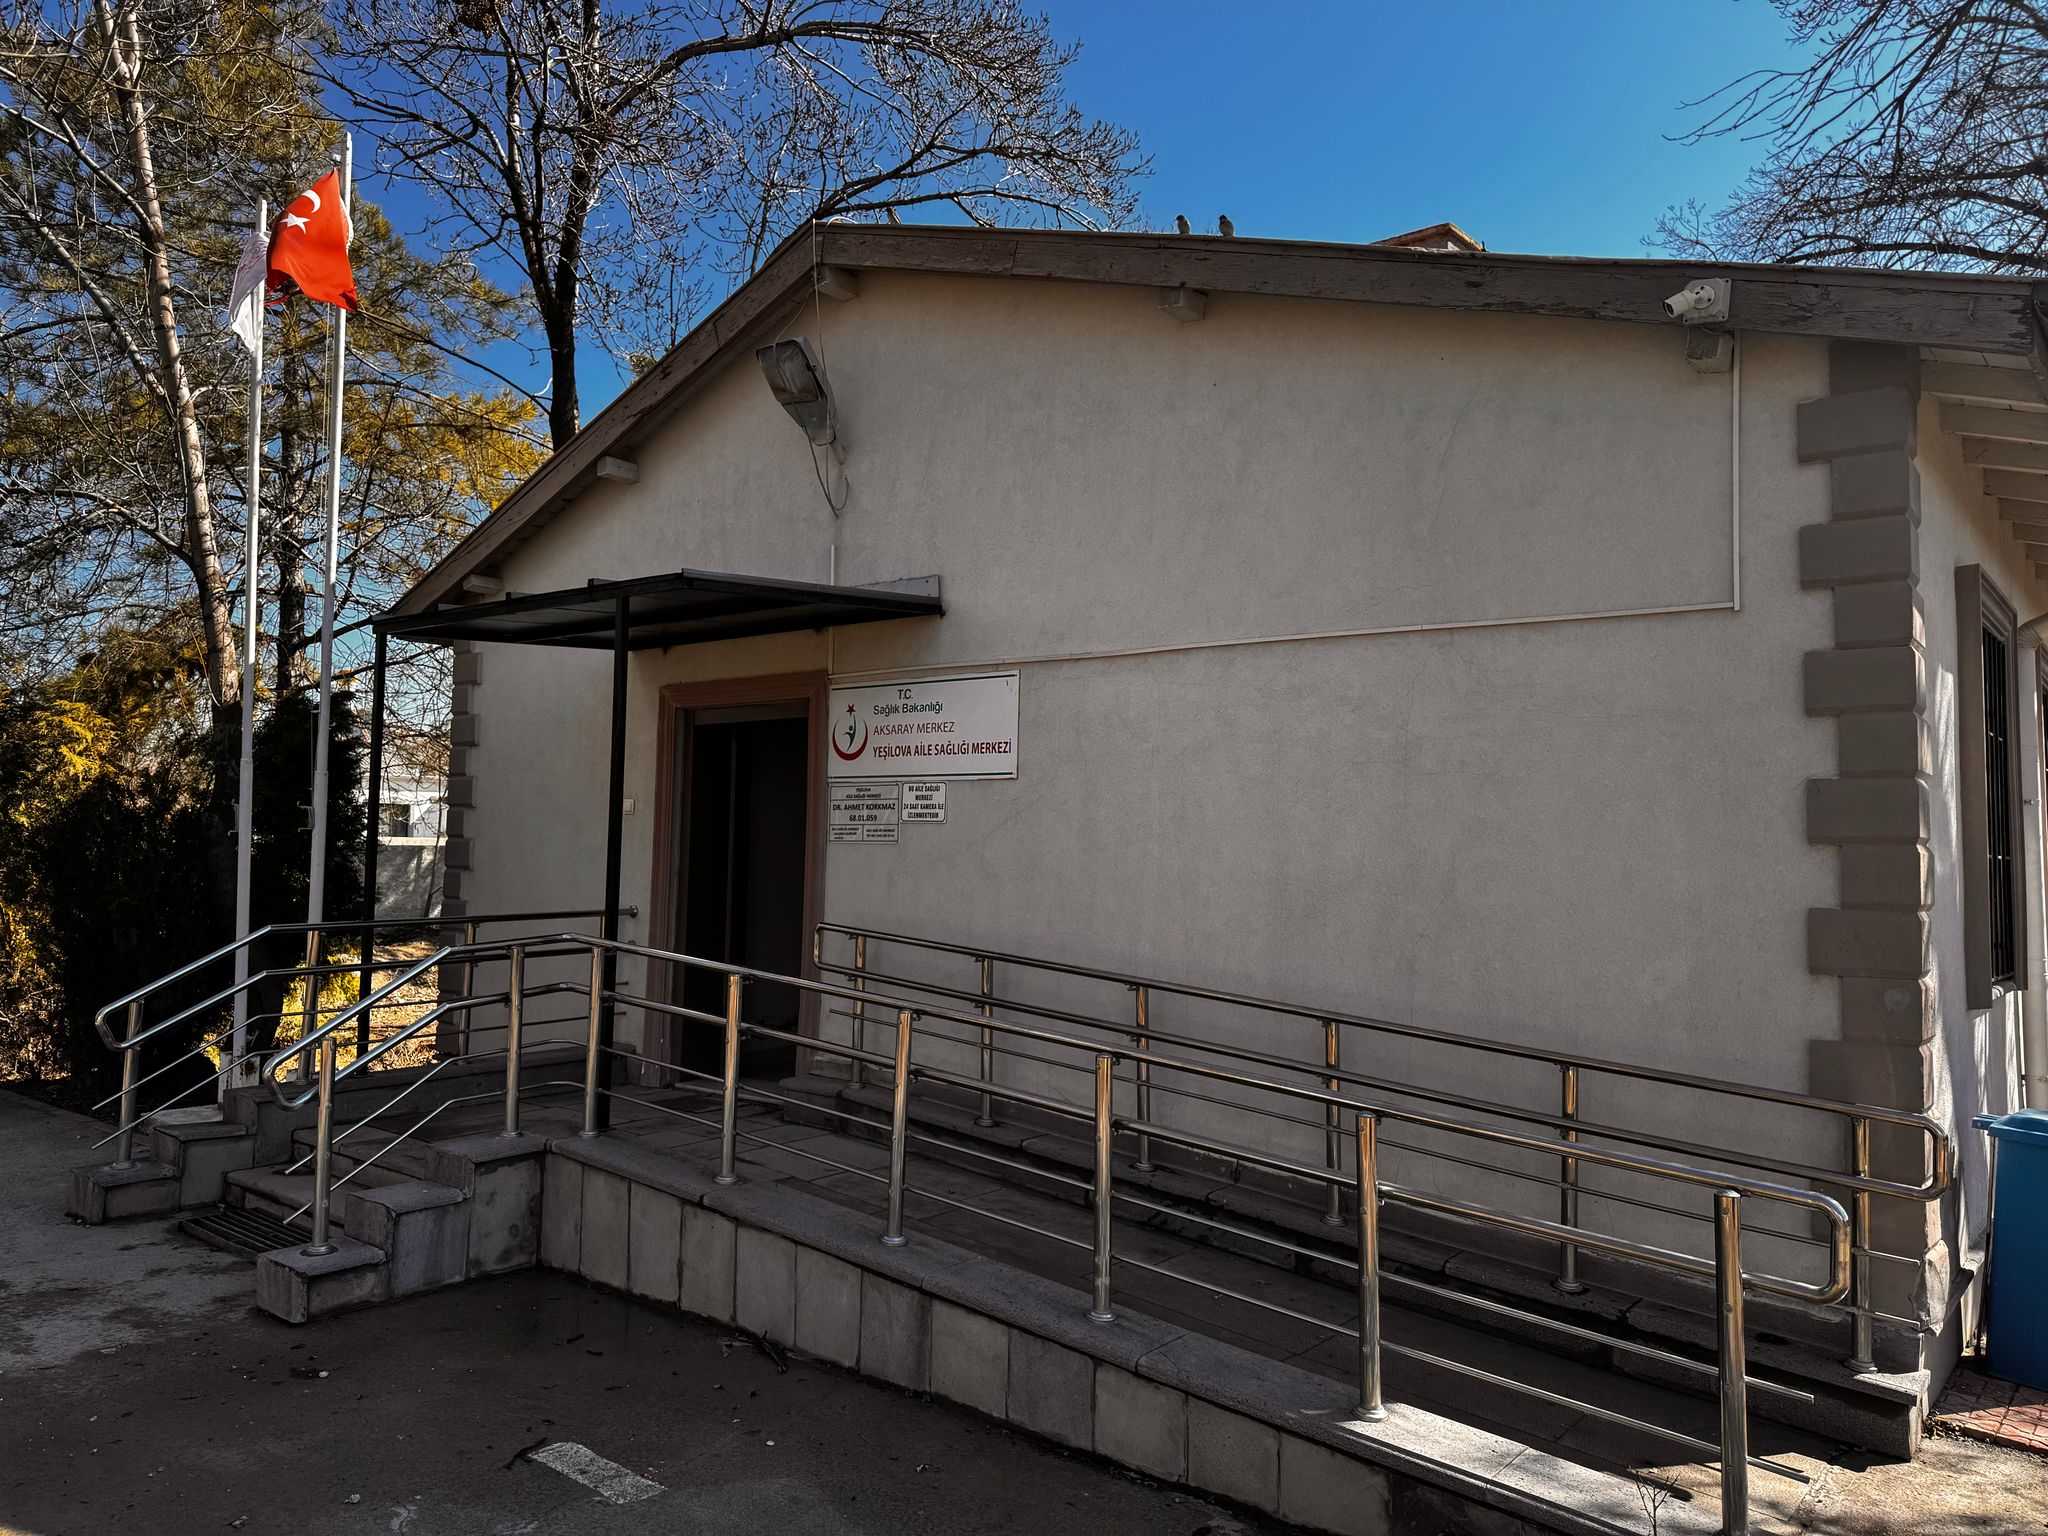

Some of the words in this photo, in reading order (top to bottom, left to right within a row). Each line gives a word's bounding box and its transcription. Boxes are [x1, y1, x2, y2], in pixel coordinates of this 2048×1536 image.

[898, 689, 913, 700] T.C.
[873, 703, 900, 717] Sağlık
[902, 702, 943, 715] Bakanlığı
[873, 723, 915, 735] AKSARAY
[917, 722, 955, 733] MERKEZ
[873, 744, 912, 760] YEŞİLOVA
[914, 742, 933, 756] AİLE
[935, 740, 969, 755] SAĞLIĞI
[972, 739, 1012, 754] MERKEZİ
